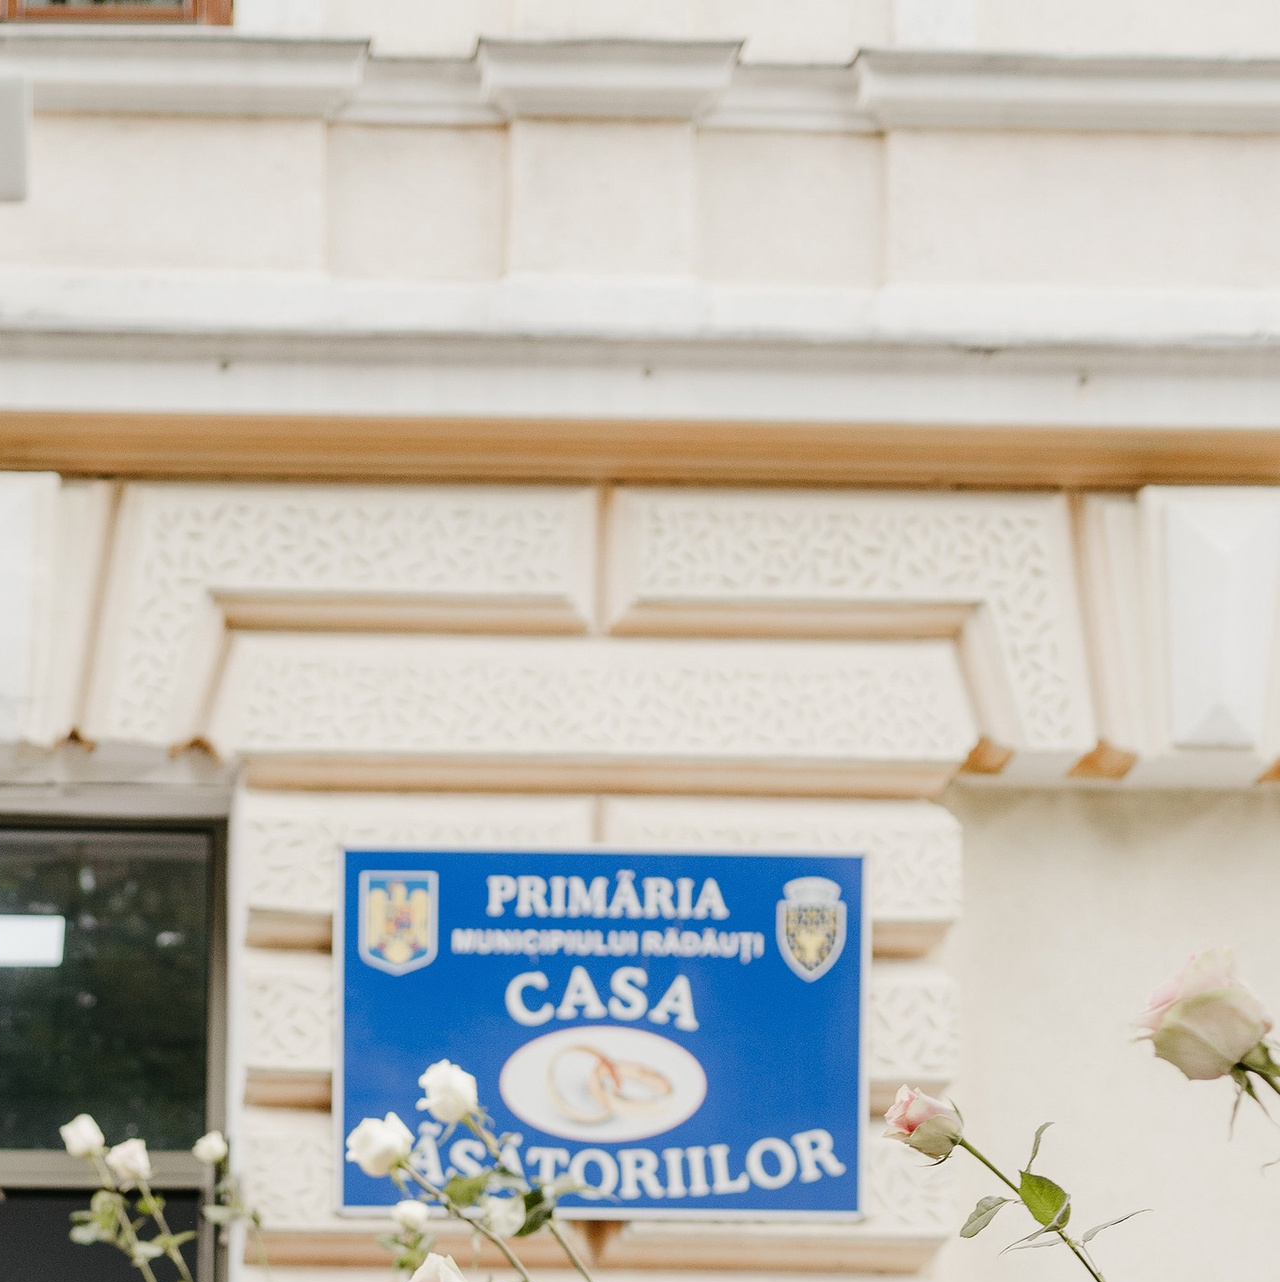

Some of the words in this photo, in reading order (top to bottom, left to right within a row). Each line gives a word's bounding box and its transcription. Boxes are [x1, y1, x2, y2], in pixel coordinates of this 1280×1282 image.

[486, 870, 730, 919] PRIMĂRIA
[451, 928, 639, 956] MUNICIPIULUI
[505, 966, 699, 1032] CASA
[370, 1122, 847, 1201] ĂSĂTORIILOR
